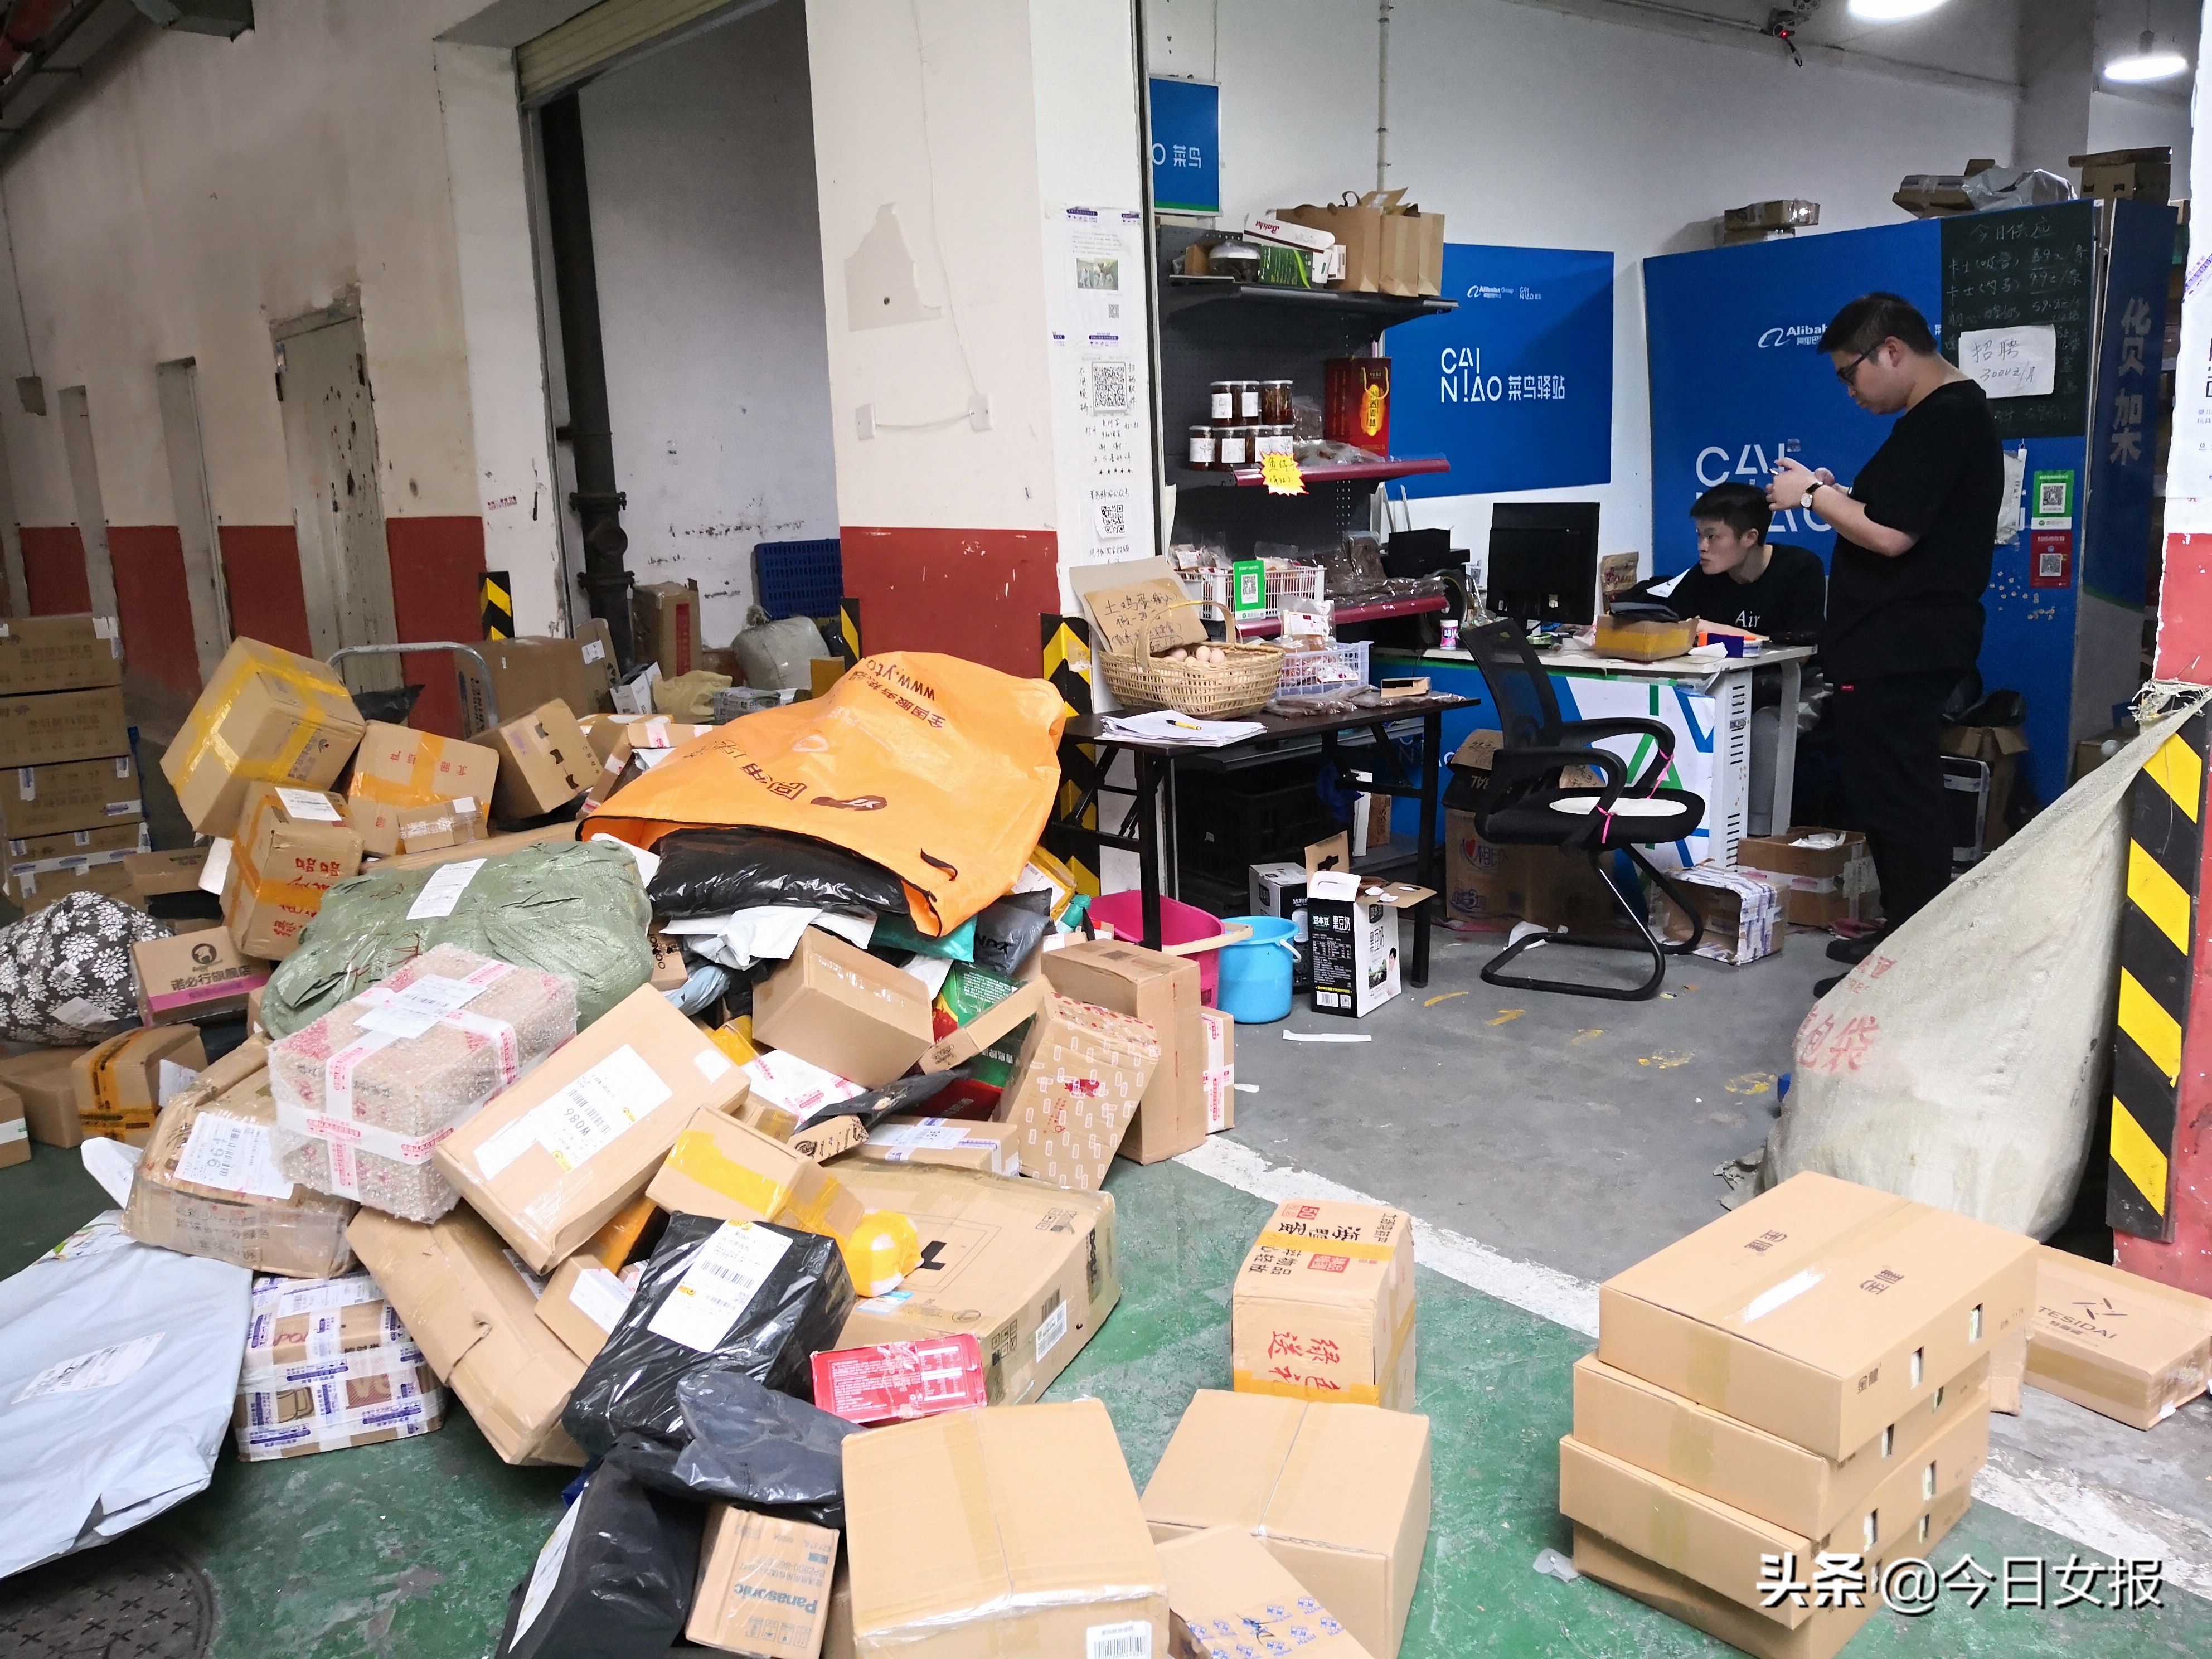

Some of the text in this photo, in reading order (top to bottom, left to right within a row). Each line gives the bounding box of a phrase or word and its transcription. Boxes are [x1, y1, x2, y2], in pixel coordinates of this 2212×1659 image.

[1173, 145, 1201, 168] 菜鸟
[1970, 222, 2056, 243] 今日供应
[1441, 348, 1481, 374] CAI
[1971, 338, 2021, 363] 招聘
[1508, 375, 1565, 401] 菜鸟驿站
[1735, 610, 1760, 629] Air
[1313, 915, 1351, 932] 豆本豆 黑豆奶
[1369, 925, 1385, 954] 黑豆奶
[565, 1107, 590, 1137] W086
[1298, 1205, 1321, 1220] 50
[2038, 1305, 2118, 1339] TESIDAI
[734, 1583, 818, 1615] Panasonic
